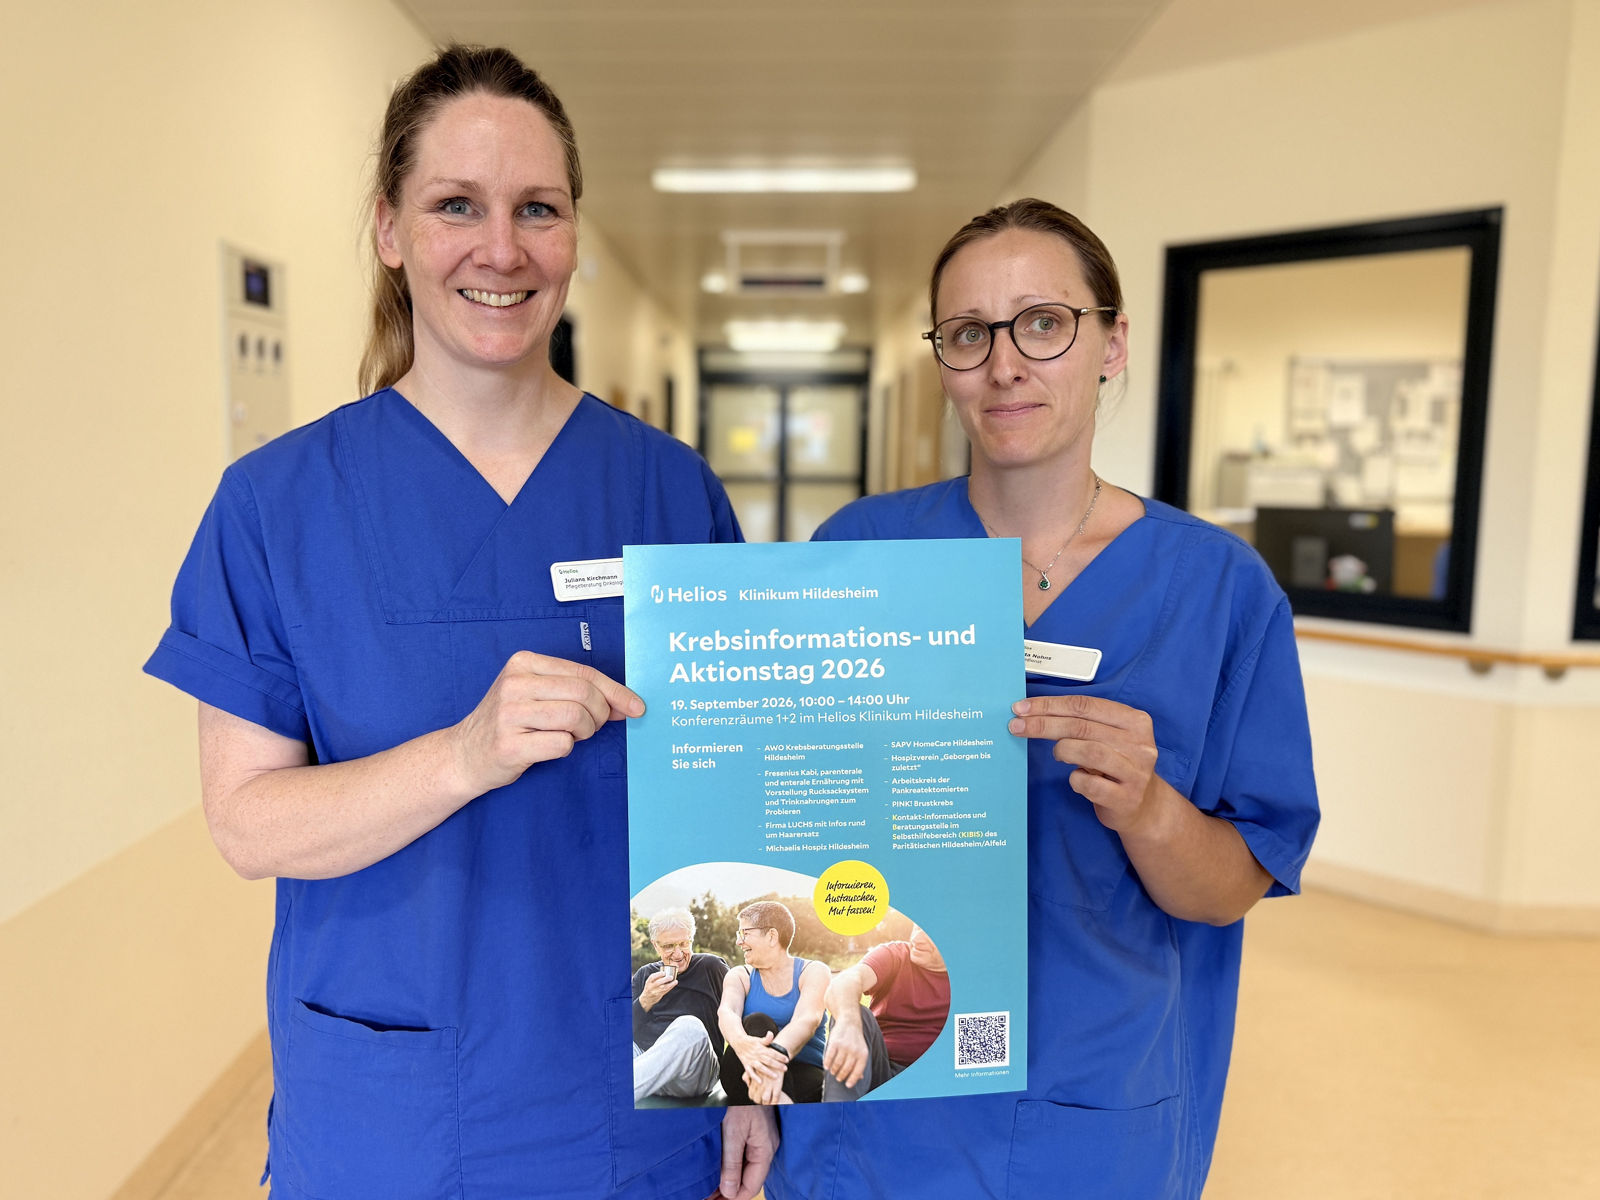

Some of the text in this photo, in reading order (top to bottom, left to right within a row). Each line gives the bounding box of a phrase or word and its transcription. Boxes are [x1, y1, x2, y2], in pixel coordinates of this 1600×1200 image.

[668, 586, 878, 602] Helios Klinikum Hildesheim
[669, 624, 975, 652] Krebsinformations- und
[669, 658, 886, 684] Aktionstag 2026
[671, 700, 687, 710] 19.
[690, 698, 759, 712] September
[762, 697, 797, 709] 2026,
[800, 696, 835, 707] 10:00
[848, 694, 883, 706] 14:00
[886, 694, 910, 705] Uhr
[672, 708, 983, 726] Konferenzräume 1+2 im Helios Klinikum Hildesheim
[672, 743, 743, 754] Informieren
[786, 742, 864, 752] Krebsberatungsstelle
[892, 754, 939, 762] Hospizverein
[672, 758, 716, 769] Sie sich
[820, 768, 862, 777] parenterale
[812, 778, 850, 787] Ernährung
[765, 787, 869, 797] Vorstellung Rucksacksystem
[781, 797, 838, 805] Trinknahrungen
[892, 812, 971, 821] Kontakt-Informations
[893, 823, 948, 831] Beratungsstelle
[893, 831, 956, 840] Selbsthilfebereich
[802, 844, 827, 852] Hospiz
[893, 840, 1006, 850] Paritätischen Hildesheim/Alfeld
[826, 880, 876, 891] Informieren,
[825, 891, 877, 903] Austauschen,
[829, 905, 876, 916] Mut fassen!
